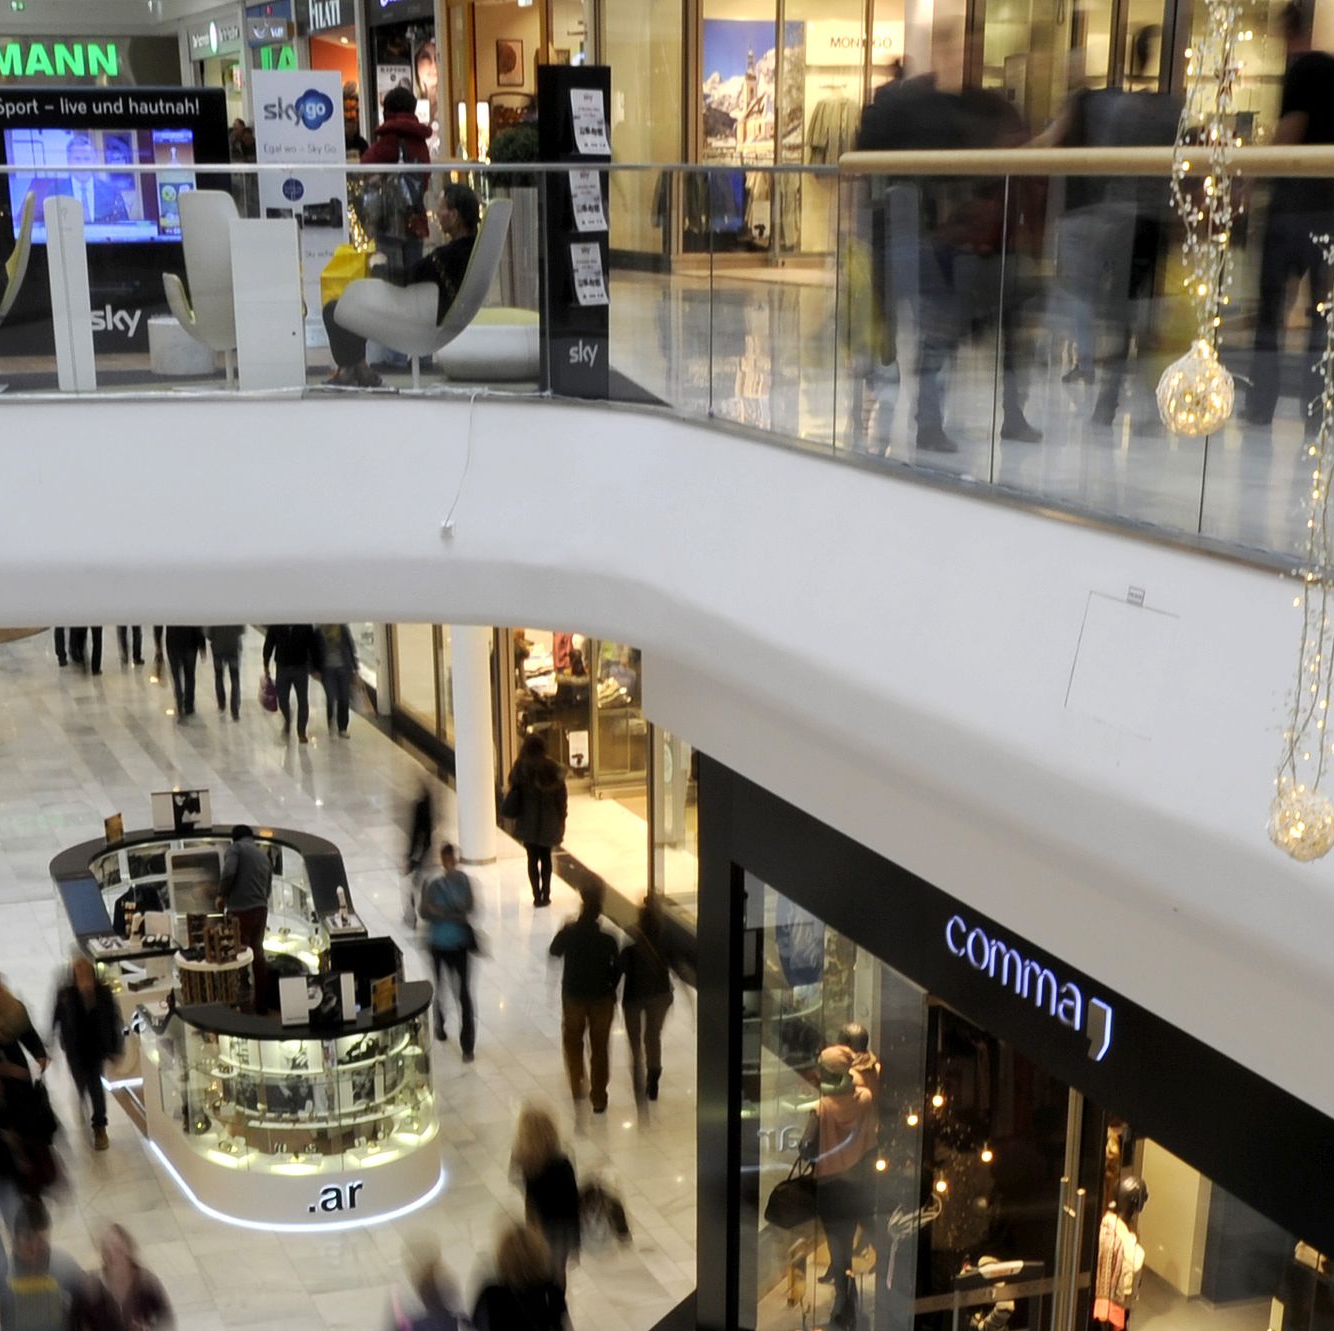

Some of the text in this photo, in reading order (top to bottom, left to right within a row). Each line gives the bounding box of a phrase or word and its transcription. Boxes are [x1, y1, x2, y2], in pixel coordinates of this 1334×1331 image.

[60, 98, 87, 115] live
[92, 97, 123, 115] und
[128, 97, 200, 115] hautnah!
[263, 97, 326, 126] sky go
[91, 304, 142, 337] sky
[569, 339, 598, 367] sky
